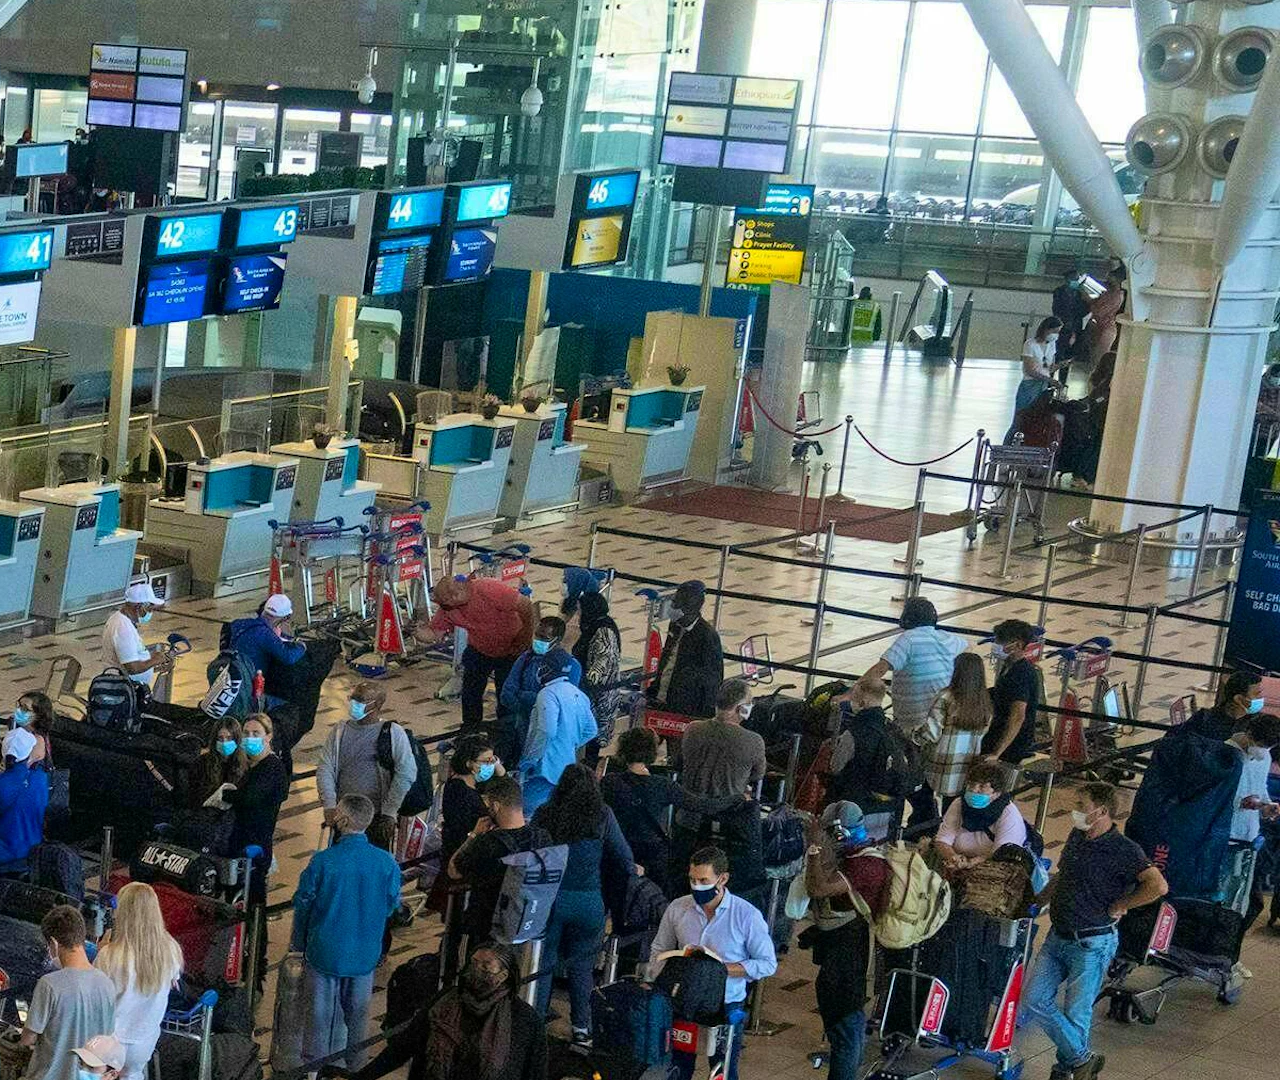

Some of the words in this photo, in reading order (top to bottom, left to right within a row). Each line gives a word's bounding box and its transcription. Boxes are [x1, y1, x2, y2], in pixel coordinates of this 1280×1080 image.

[488, 187, 510, 211] 45
[589, 180, 609, 203] 46
[390, 197, 412, 223] 44
[159, 221, 184, 248] 42
[273, 210, 297, 236] 43
[27, 234, 52, 264] 41
[753, 241, 773, 249] Prayer
[4, 312, 27, 322] TOWN
[1245, 590, 1264, 600] SELF
[141, 846, 158, 864] ALL
[162, 855, 190, 875] STAR
